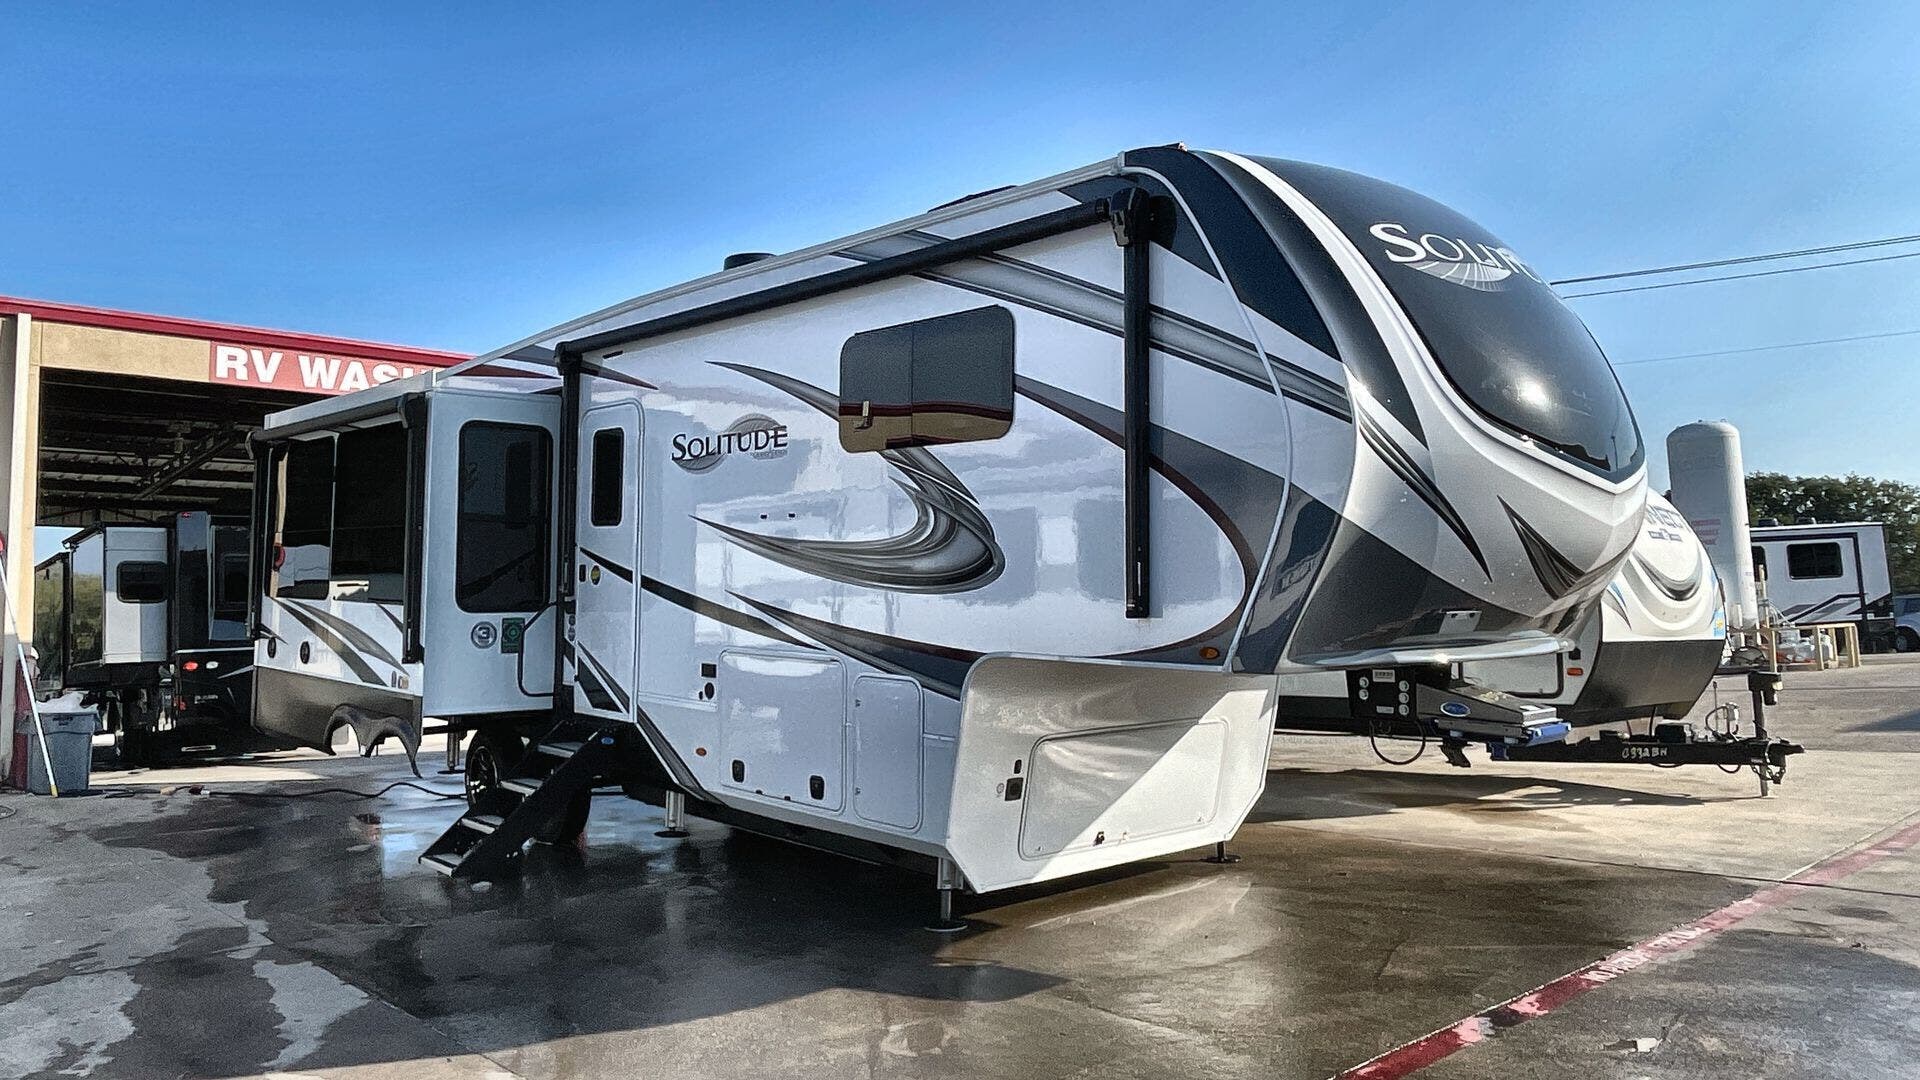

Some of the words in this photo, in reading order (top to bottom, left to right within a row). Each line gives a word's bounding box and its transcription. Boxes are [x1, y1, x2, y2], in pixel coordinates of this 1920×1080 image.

[215, 345, 284, 383] RV
[297, 354, 430, 392] WAS
[671, 425, 788, 461] SOLITUDE
